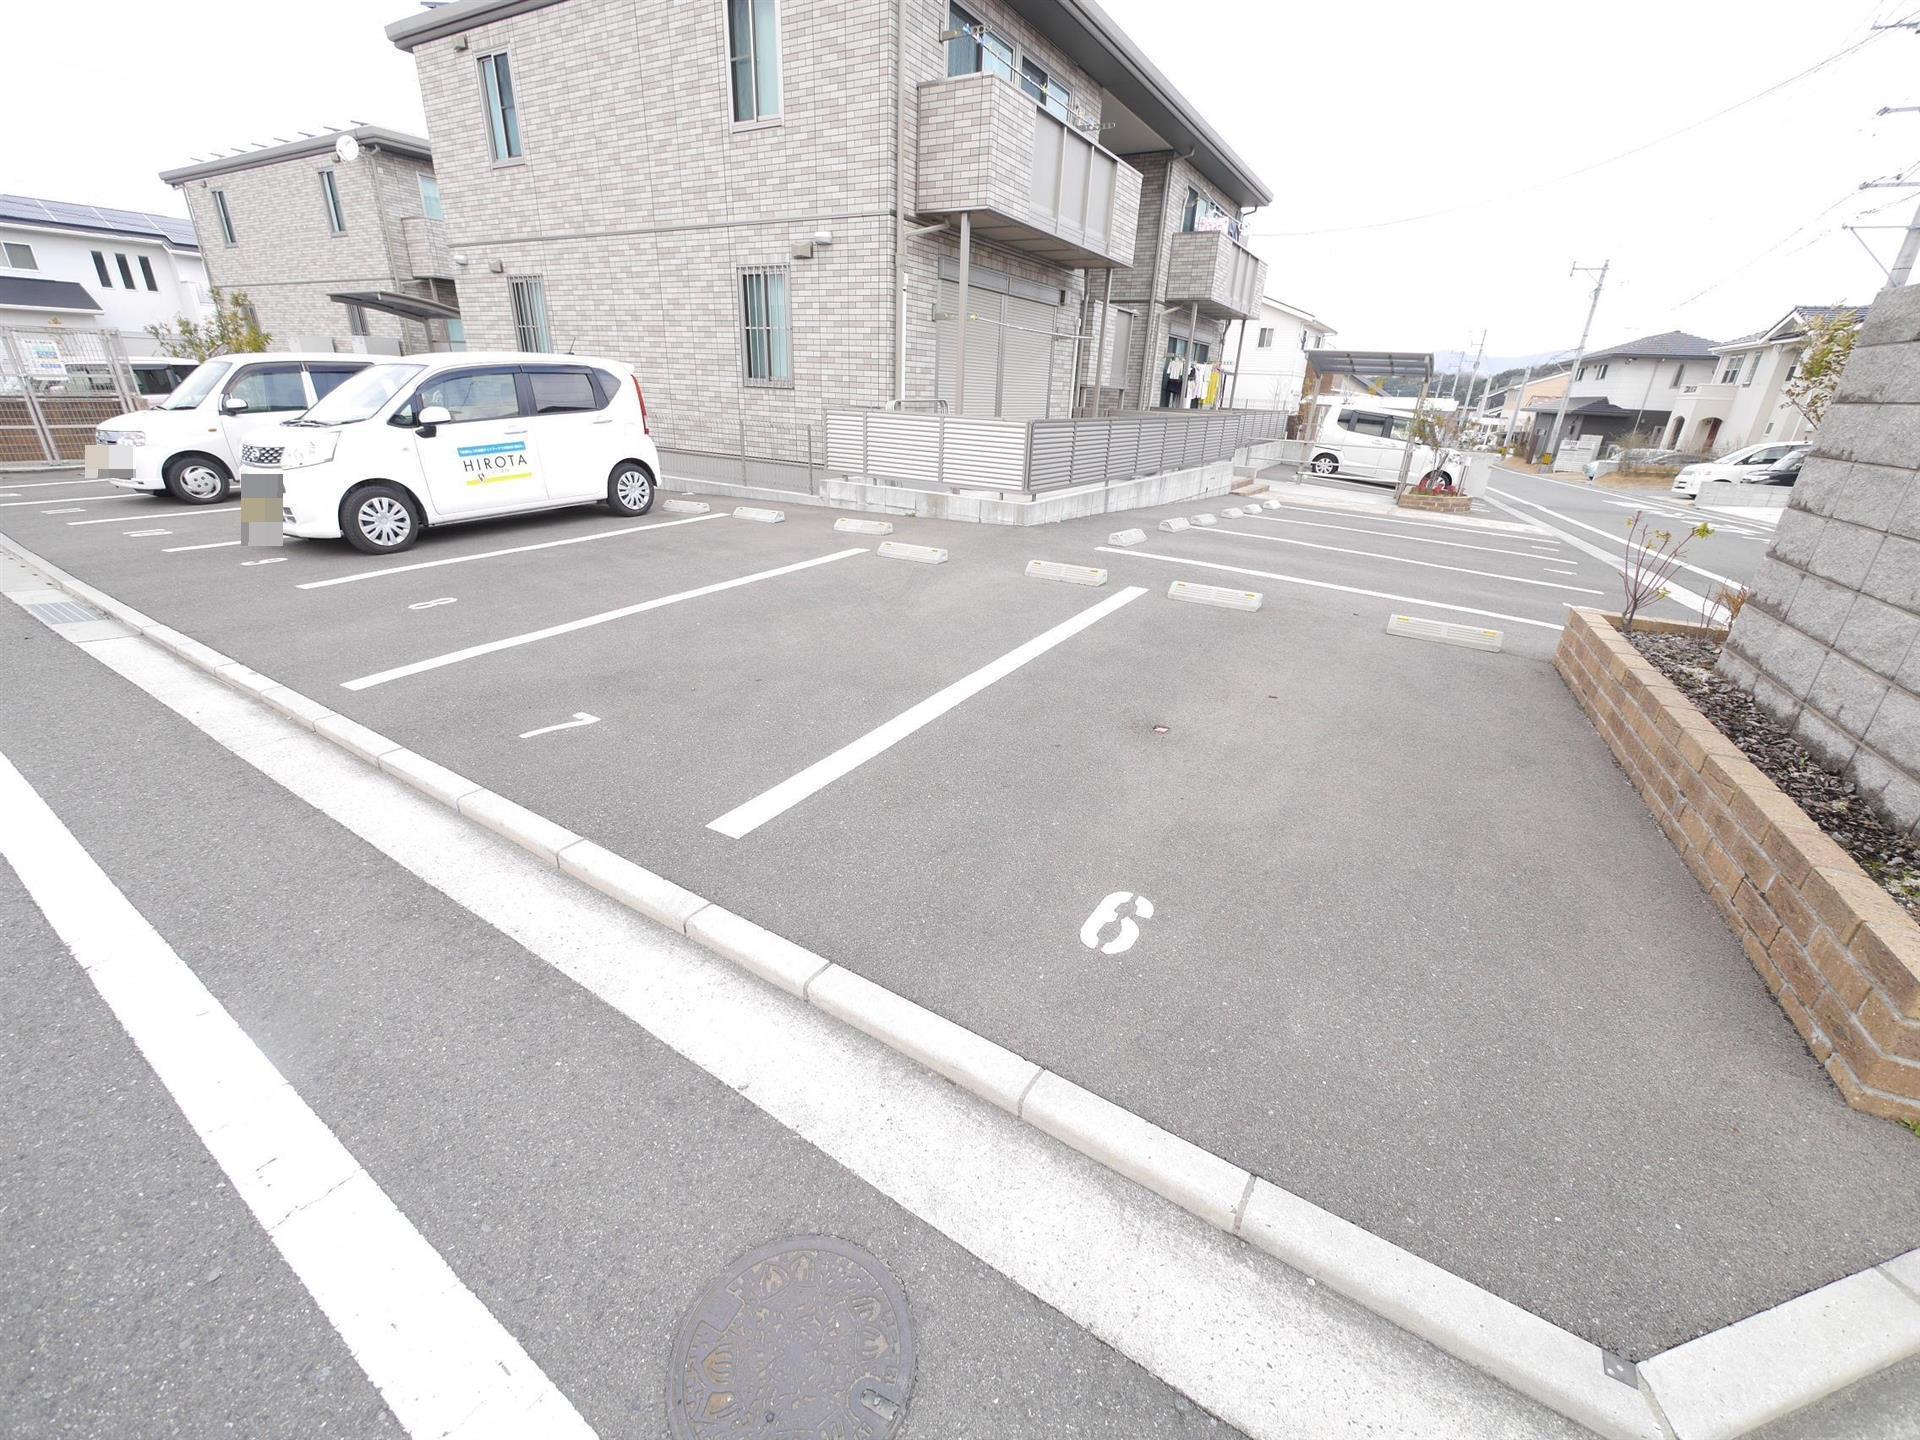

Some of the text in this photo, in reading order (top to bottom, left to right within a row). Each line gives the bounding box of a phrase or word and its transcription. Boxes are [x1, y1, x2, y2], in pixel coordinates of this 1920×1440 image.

[463, 454, 527, 472] HIROTA
[407, 597, 458, 610] 8
[518, 711, 601, 739] 7
[1079, 890, 1155, 955] 6
